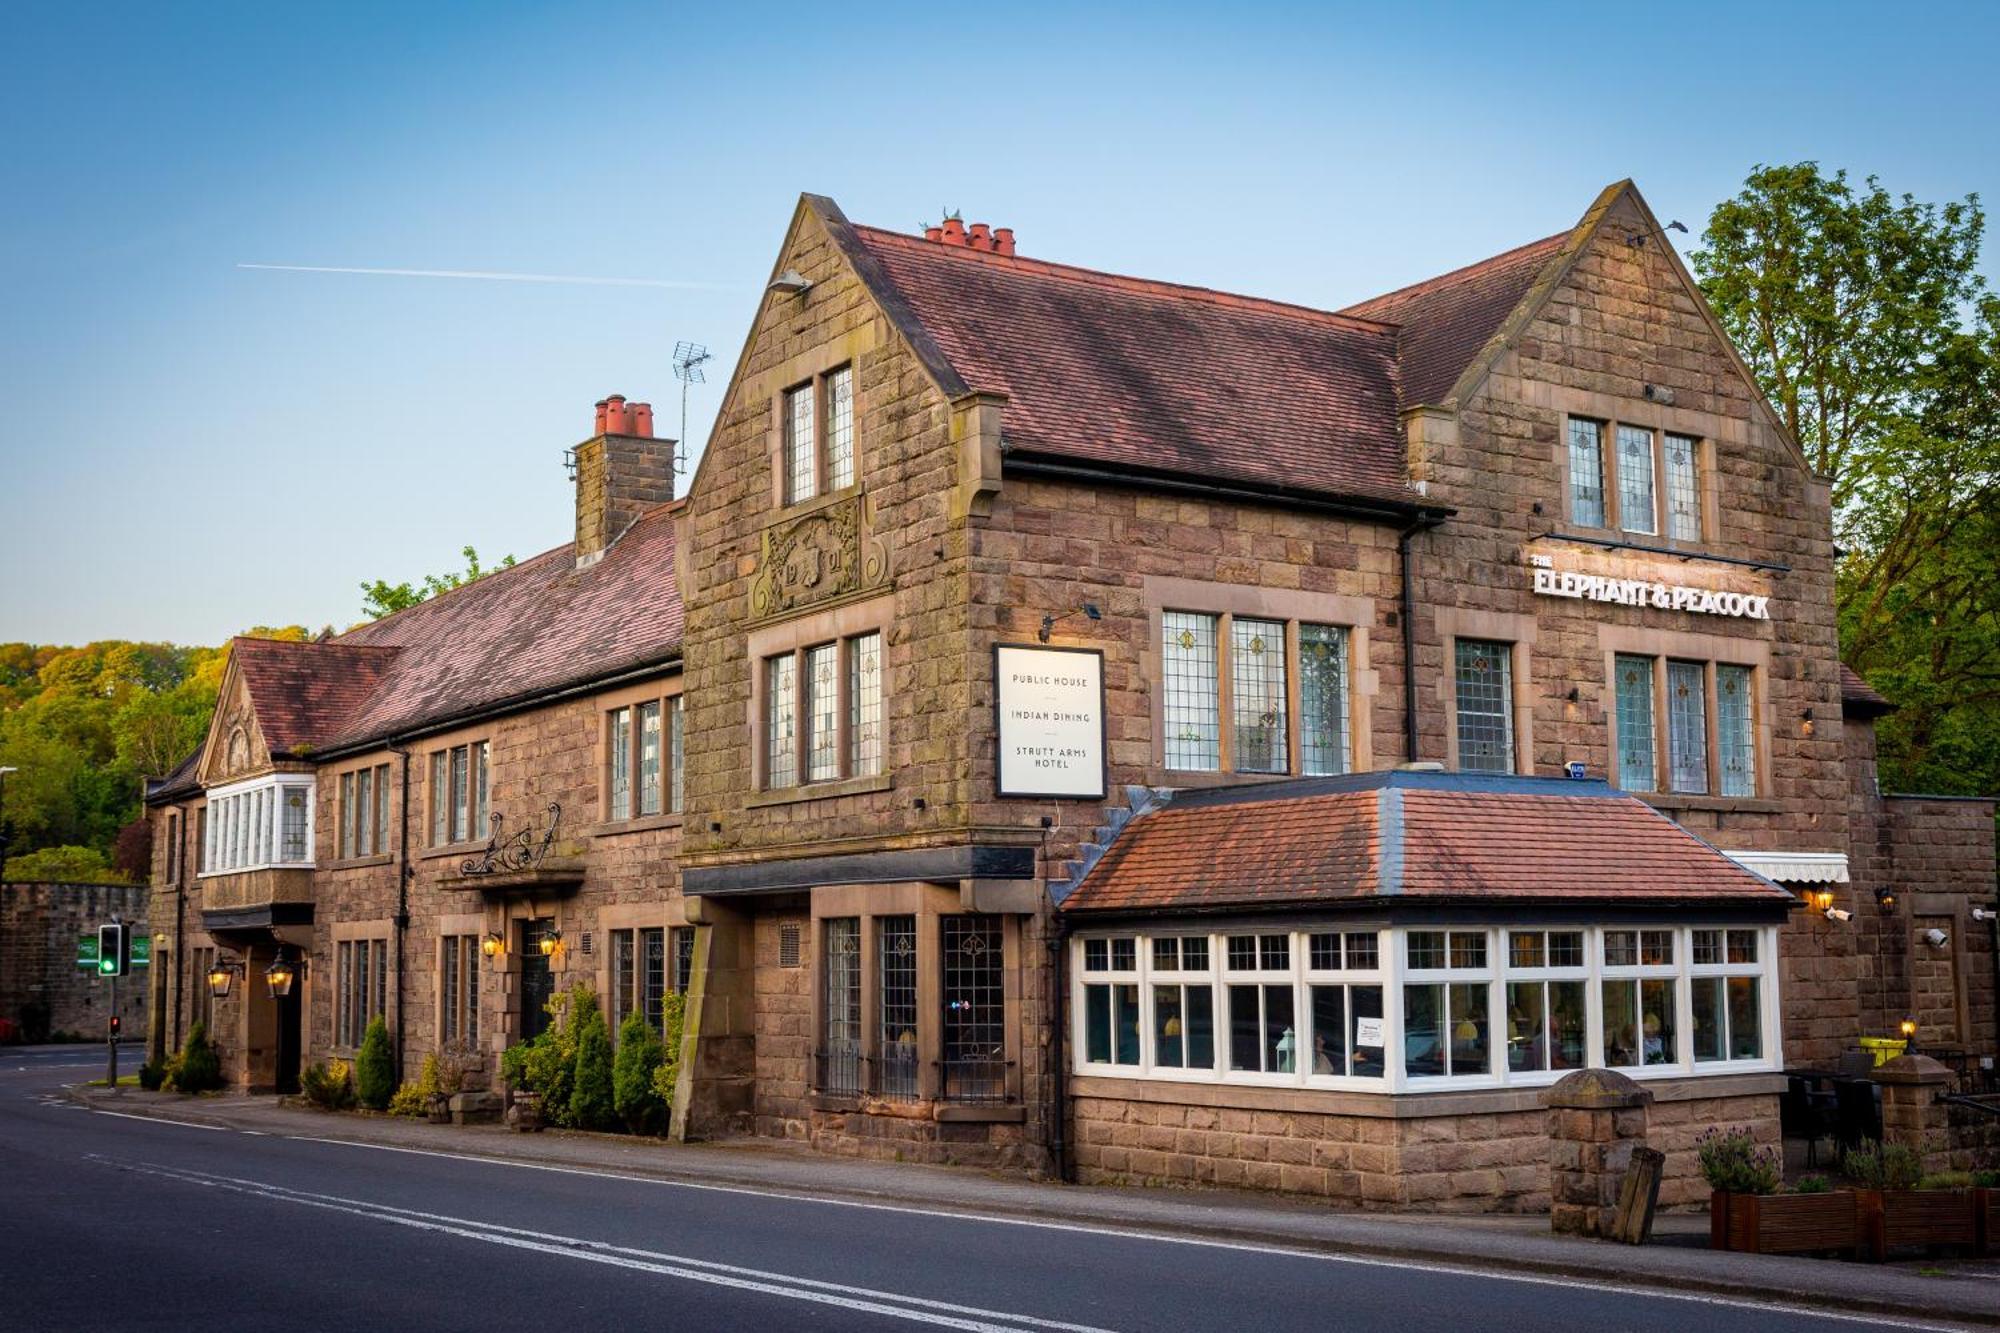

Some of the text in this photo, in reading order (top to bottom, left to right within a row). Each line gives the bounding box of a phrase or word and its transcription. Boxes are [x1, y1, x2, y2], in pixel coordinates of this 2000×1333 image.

[1530, 554, 1552, 567] THE
[1534, 569, 1650, 606] ELEPHANT
[1672, 586, 1769, 619] PEACOCK
[1012, 674, 1088, 687] PUBLIC HOUSE
[1011, 711, 1090, 723] INDIAN DINING
[1016, 747, 1087, 758] STRUTT ARMS
[1035, 759, 1069, 769] HOTEL
